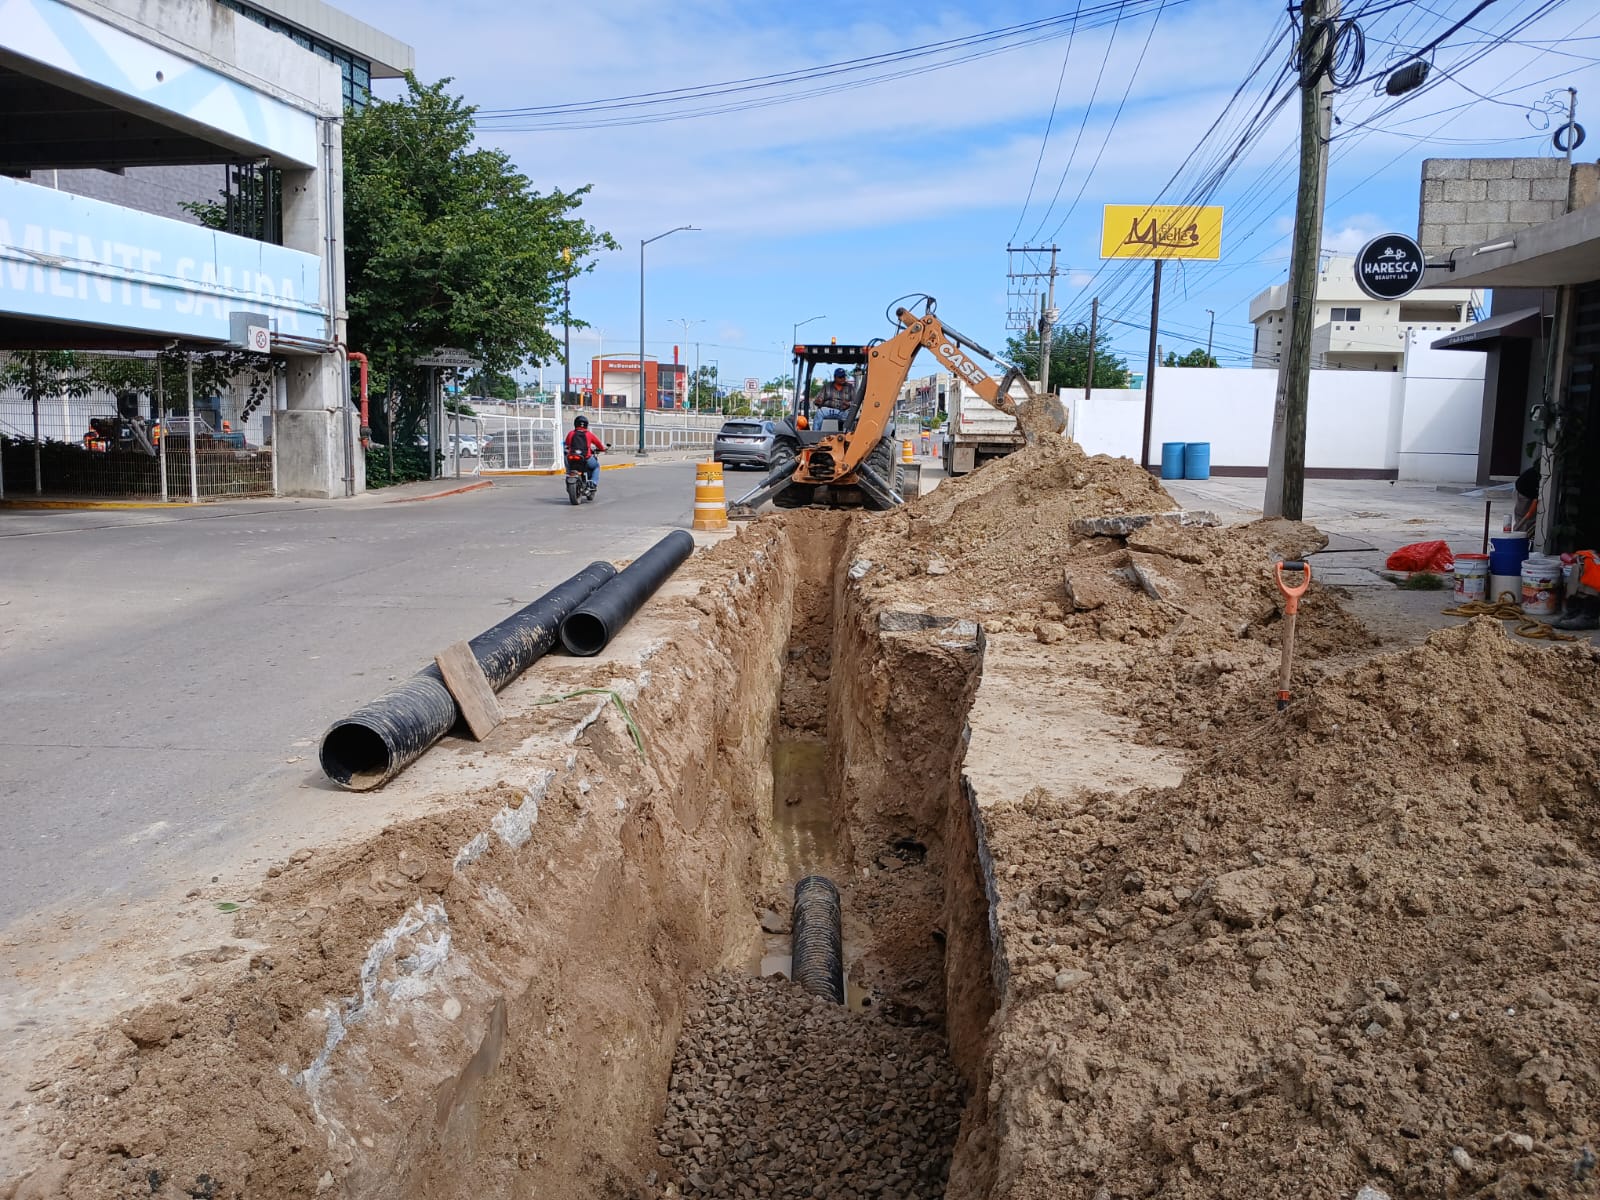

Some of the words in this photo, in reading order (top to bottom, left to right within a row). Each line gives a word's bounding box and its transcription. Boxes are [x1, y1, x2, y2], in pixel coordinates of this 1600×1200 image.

[1364, 262, 1418, 274] KARESCA
[175, 257, 299, 331] SALIDA
[939, 343, 987, 384] CASE
